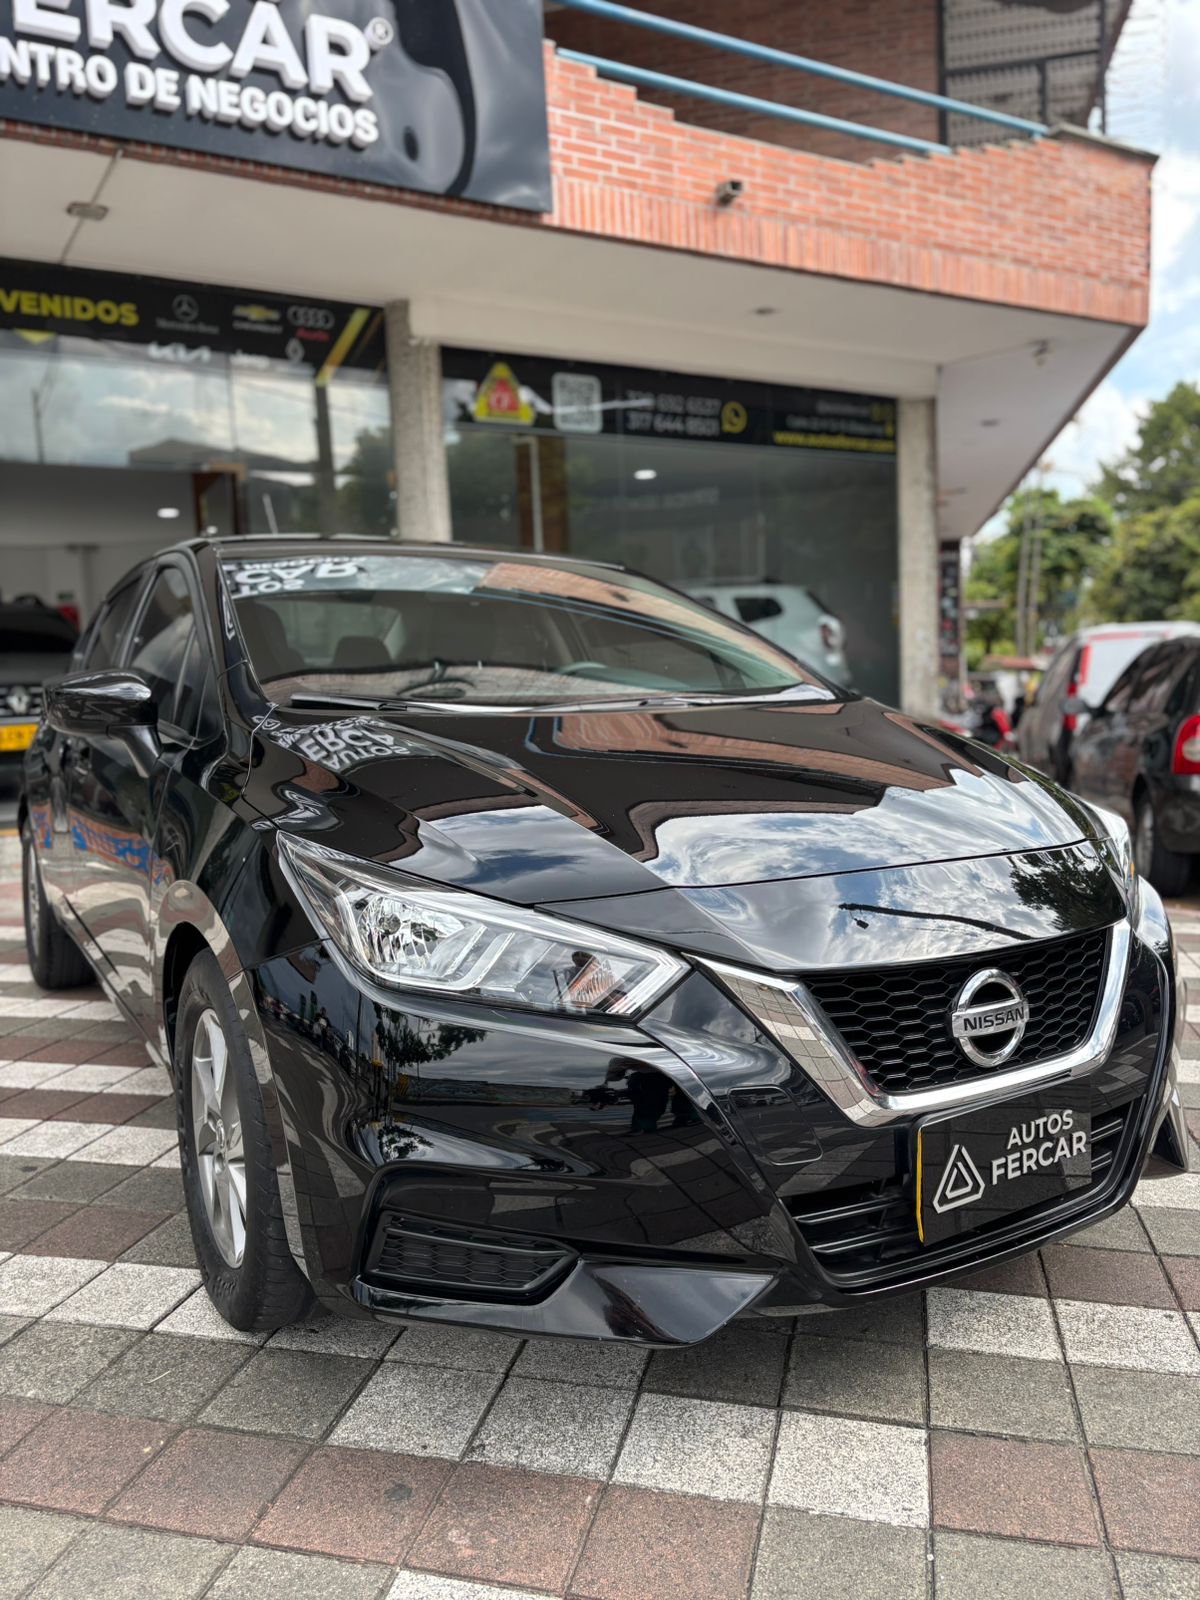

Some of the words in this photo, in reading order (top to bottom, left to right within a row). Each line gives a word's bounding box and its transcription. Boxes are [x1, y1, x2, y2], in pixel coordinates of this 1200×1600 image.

[0, 36, 118, 98] NTRO
[124, 61, 181, 110] DE
[186, 73, 379, 146] NEGOCIOS
[0, 287, 140, 327] VENIDOS
[962, 1006, 1025, 1032] NISSAN
[1007, 1109, 1073, 1150] AUTOS
[991, 1131, 1087, 1185] FERCAR
